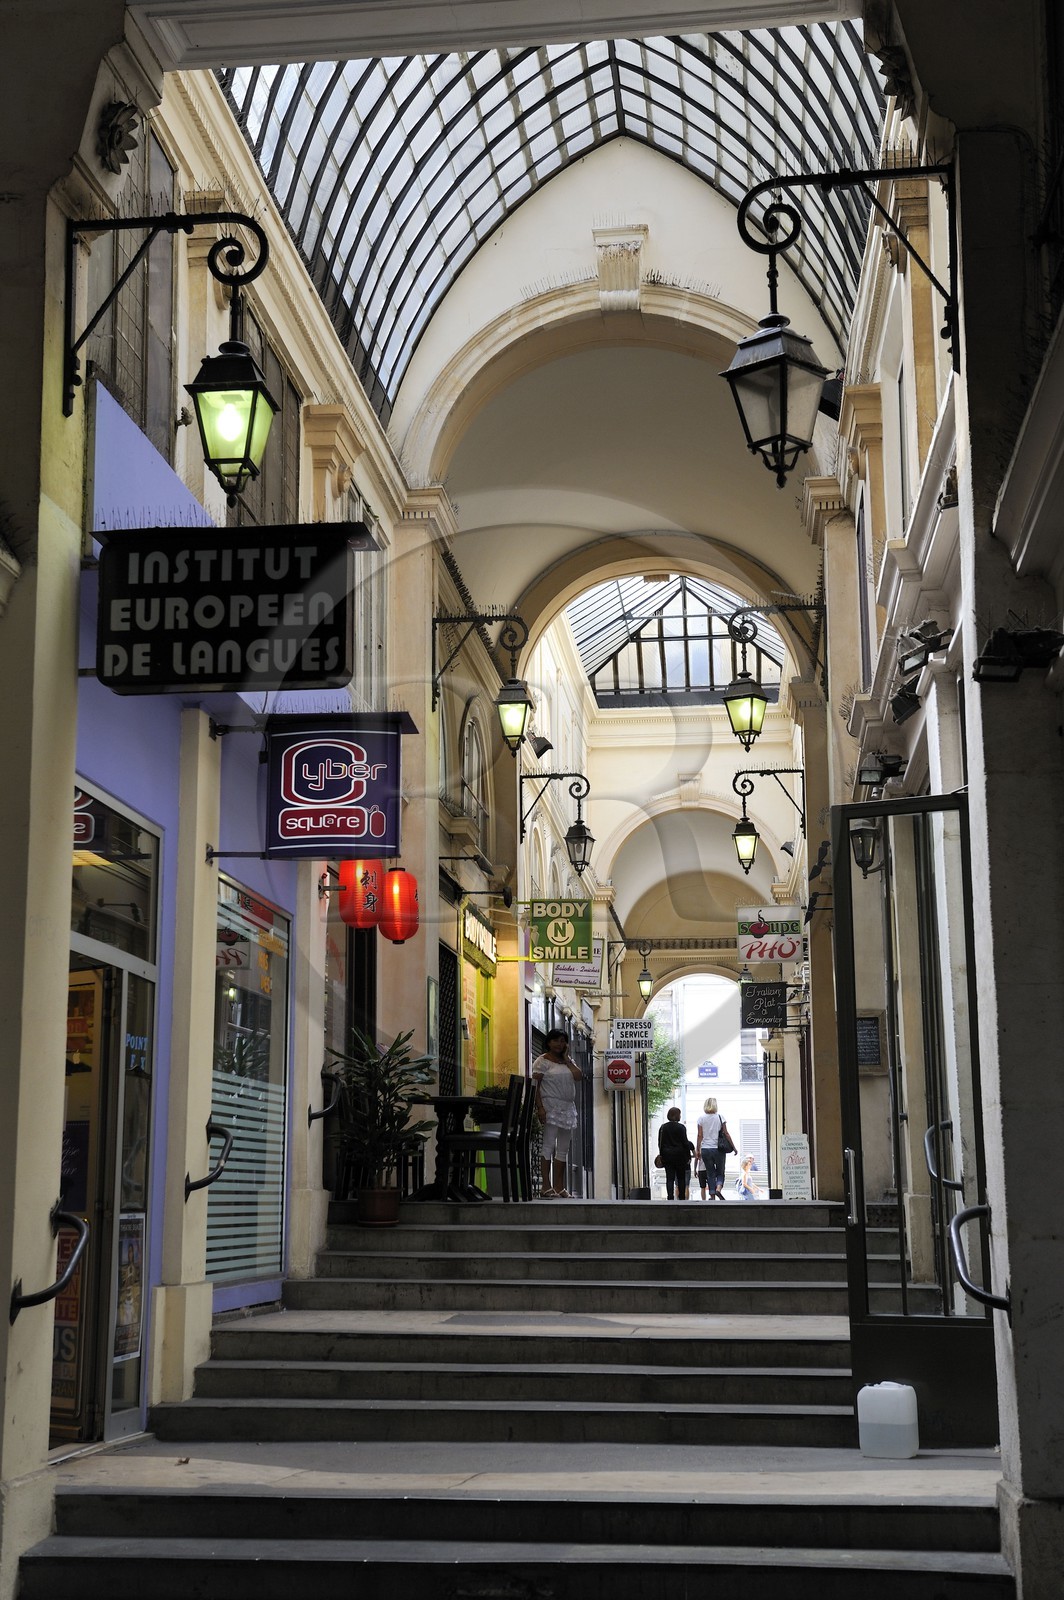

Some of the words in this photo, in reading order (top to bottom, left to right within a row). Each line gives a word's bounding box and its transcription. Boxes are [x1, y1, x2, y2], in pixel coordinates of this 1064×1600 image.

[127, 546, 318, 585] INSTITUT
[109, 591, 334, 632] EUROPEEN
[103, 643, 150, 677] DE
[172, 636, 339, 676] LANGUES
[532, 902, 588, 918] BODY
[532, 946, 588, 960] SMILE
[753, 997, 776, 1010] Plat
[616, 1021, 652, 1030] EXPRESSO
[125, 1032, 148, 1051] POINT
[619, 1030, 649, 1039] SERVICE
[615, 1039, 654, 1049] CORDONNERIE
